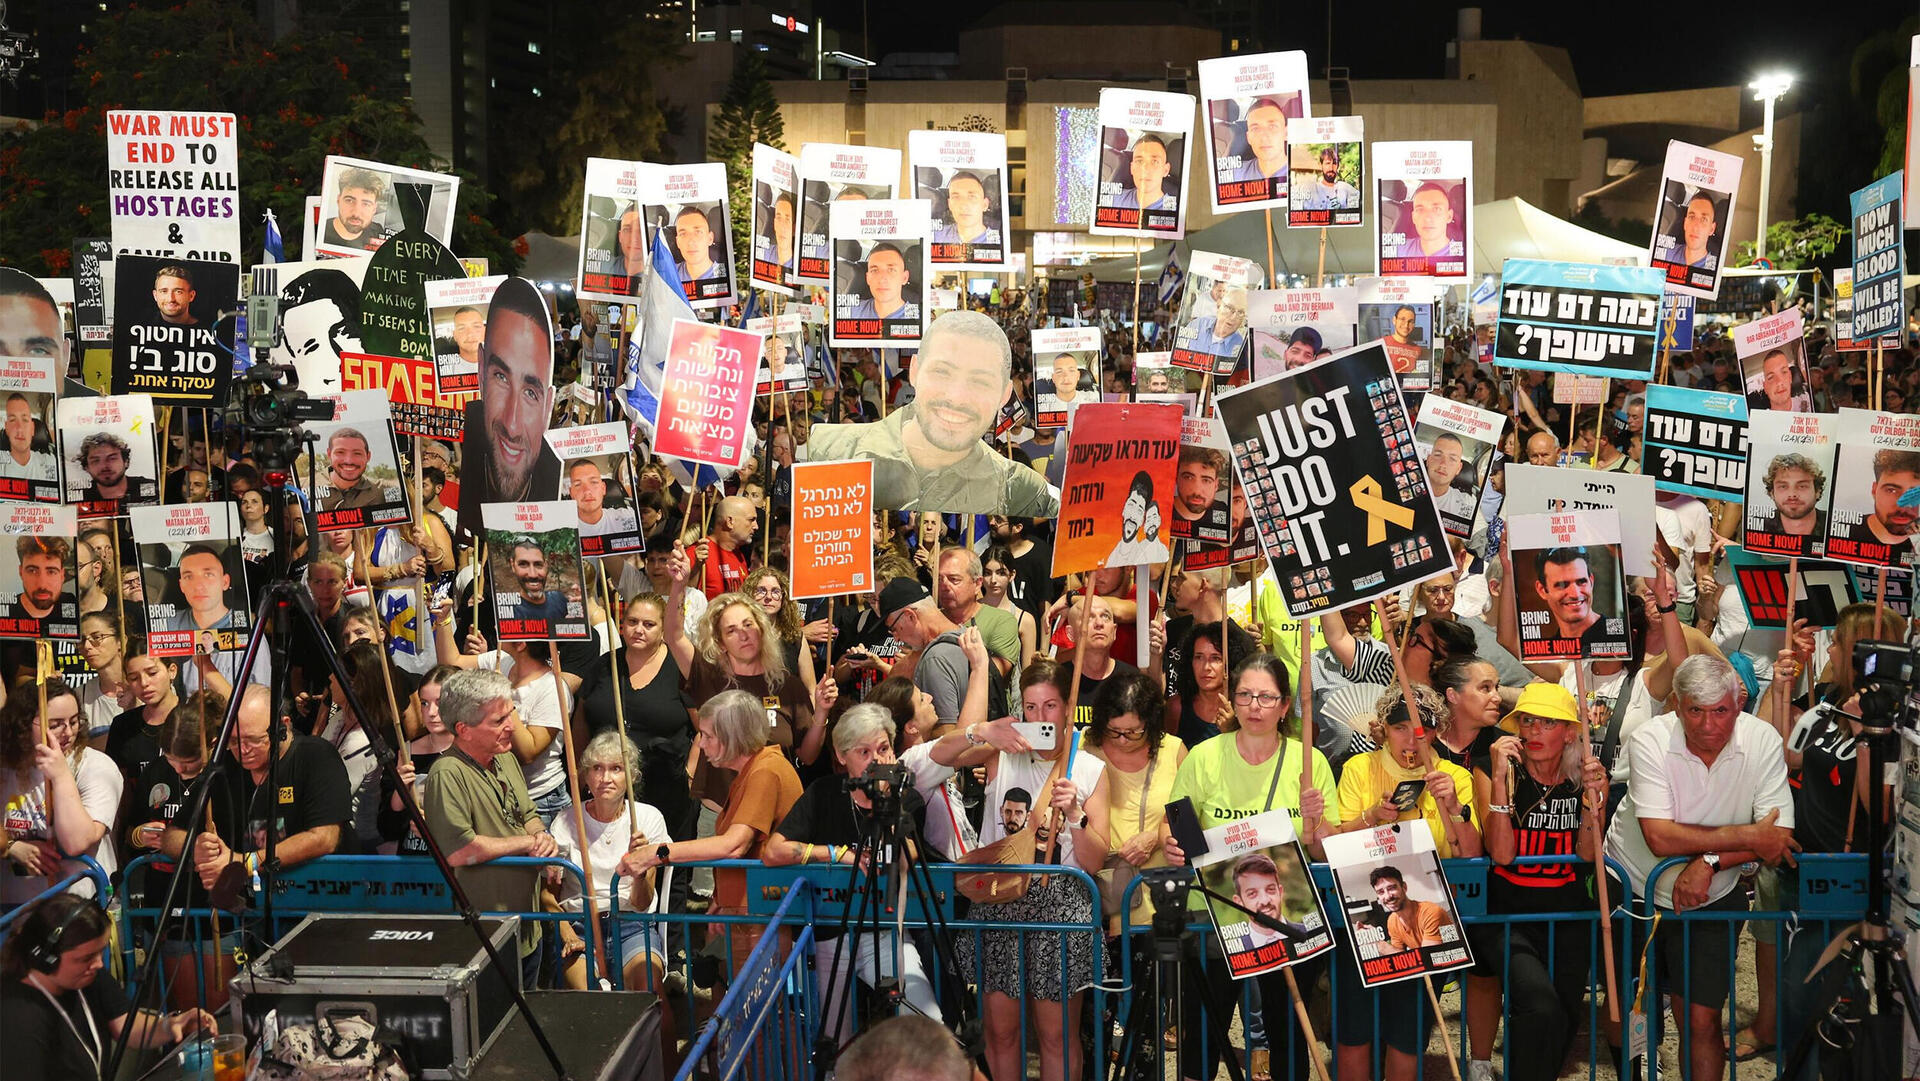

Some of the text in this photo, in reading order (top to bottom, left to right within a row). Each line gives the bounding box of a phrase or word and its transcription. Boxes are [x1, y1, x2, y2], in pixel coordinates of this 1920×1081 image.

[108, 114, 234, 138] WAR MUST
[127, 142, 217, 164] END TO
[831, 161, 846, 169] MATAN
[1217, 155, 1242, 171] BRING
[110, 170, 237, 191] RELEASE ALL
[1100, 182, 1123, 195] BRING
[1219, 178, 1270, 199] HOME NOW!
[115, 195, 233, 218] HOSTAGES
[1098, 208, 1119, 221] HOME
[861, 218, 898, 226] MATAN ANGREST
[1291, 209, 1330, 222] HOME NOW!
[1860, 203, 1891, 235] HOW
[168, 222, 184, 244] &
[802, 233, 825, 246] BRING
[1382, 233, 1406, 246] BRING
[1657, 234, 1676, 249] BRING
[1857, 225, 1895, 258] MUCH
[395, 240, 443, 265] EVERY
[587, 248, 610, 261] BRING
[802, 244, 816, 258] HIM
[1382, 246, 1397, 258] HIM
[586, 261, 601, 273] HIM
[801, 259, 822, 272] HOME
[1382, 258, 1429, 271] HOME NOW!
[1856, 250, 1897, 282] BLOOD
[372, 266, 408, 285] TIME
[584, 274, 607, 287] HOME
[365, 291, 417, 310] MAKING
[837, 294, 860, 306] BRING
[1505, 289, 1550, 317] עוד
[1854, 278, 1898, 312] WILL BE
[837, 306, 851, 318] HIM
[1274, 302, 1335, 312] GALI AND ZIV BERMAN
[1557, 294, 1593, 321] דם
[1599, 297, 1656, 326] כמה
[362, 312, 415, 334] IT SEEMS
[836, 320, 883, 333] HOME NOW!
[1854, 302, 1899, 336] SPILLED?
[130, 325, 217, 347] אין חטוף
[1178, 327, 1199, 340] BRING
[1514, 324, 1635, 362] יישפך?
[689, 342, 742, 364] תקווה
[171, 350, 217, 374] סוג
[675, 359, 744, 384] ונחישות
[128, 374, 216, 392] עסקה אחת.
[672, 379, 739, 402] ציבורית
[676, 399, 734, 421] משנים
[1038, 413, 1055, 423] HOME
[669, 417, 735, 441] מציאות
[1257, 385, 1356, 466] JUST
[1650, 413, 1733, 449] דם עוד
[1790, 425, 1804, 434] ALON
[1870, 425, 1883, 434] GUY
[1070, 439, 1178, 469] עוד תראו שקיעות
[800, 483, 866, 503] לא נתרגל
[1069, 482, 1104, 506] ורודות
[1270, 455, 1337, 516] DO
[1584, 483, 1616, 494] הייתי
[335, 508, 364, 525] NOW!
[803, 500, 863, 519] לא נרפה
[1748, 505, 1775, 519] BRING
[1832, 508, 1863, 526] BRING
[166, 516, 211, 527] MATAN ANGREST
[1068, 517, 1095, 540] ביחד
[1551, 525, 1576, 534] DROR OR
[1747, 517, 1764, 531] HIM
[1830, 521, 1850, 538] HIM
[803, 527, 861, 543] עד שכולם
[1286, 510, 1350, 567] IT.
[1747, 532, 1802, 550] HOME NOW!
[814, 542, 851, 554] חוזרים
[1187, 541, 1200, 553] HIM
[1828, 538, 1891, 560] HOME NOW!
[812, 554, 853, 568] הביתה.
[1187, 548, 1229, 566] HOME NOW!
[496, 592, 522, 605] BRING
[149, 604, 176, 618] BRING
[498, 606, 514, 619] HIM
[1520, 611, 1550, 625] BRING
[150, 618, 168, 632] HIM
[500, 619, 548, 633] HOME NOW!
[1522, 625, 1541, 639] HIM
[1523, 638, 1581, 655] HOME NOW!
[1241, 822, 1250, 831] דוד
[1224, 829, 1258, 846] DAVID CUNIO
[1380, 836, 1397, 847] CUNIO
[368, 929, 434, 941] VOICE
[1221, 922, 1250, 940] BRING
[1357, 926, 1385, 946] BRING
[1225, 937, 1246, 953] HIM
[1230, 940, 1287, 970] HOME NOW!
[1364, 949, 1424, 977] HOME NOW!
